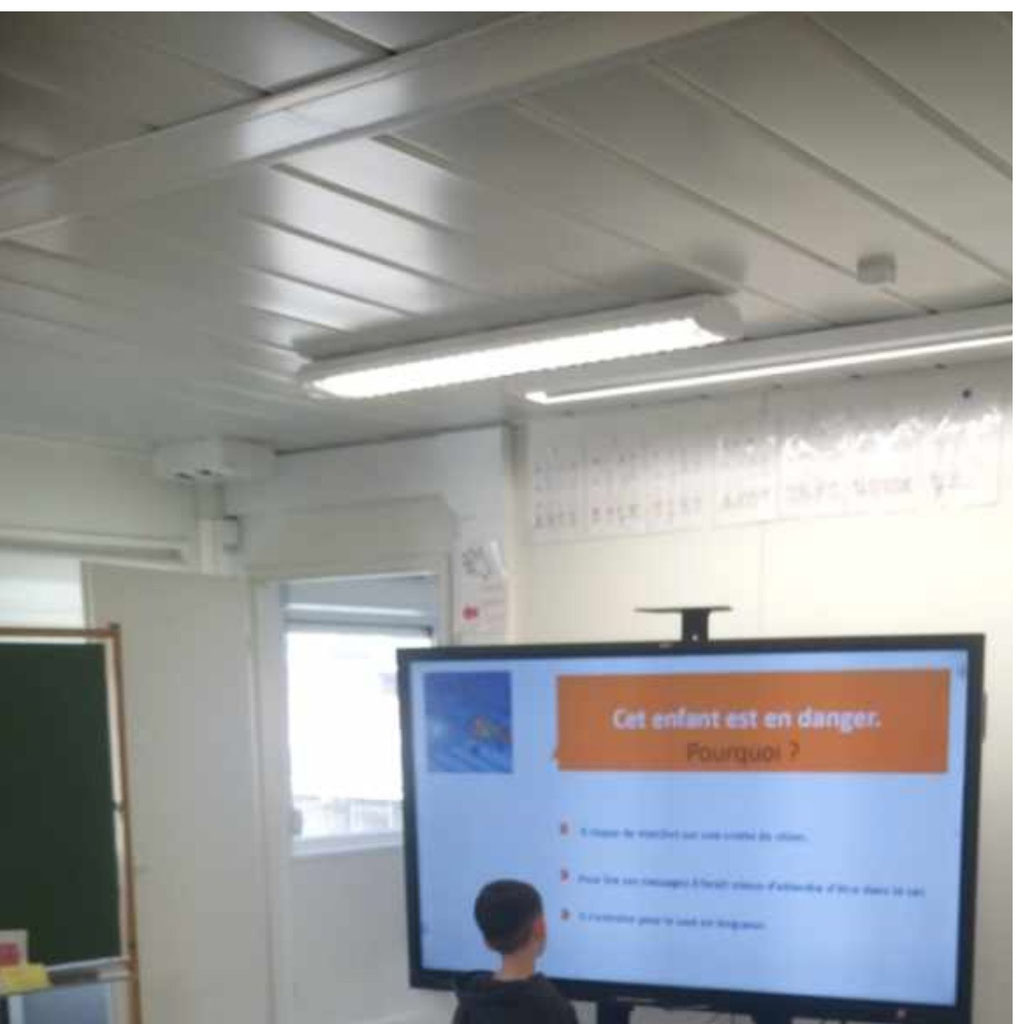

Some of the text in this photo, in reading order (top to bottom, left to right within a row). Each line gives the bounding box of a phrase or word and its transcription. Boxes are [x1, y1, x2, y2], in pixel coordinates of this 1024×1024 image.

[612, 706, 882, 734] Cet enfant est en danger.
[686, 740, 801, 764] Pourquoi ?
